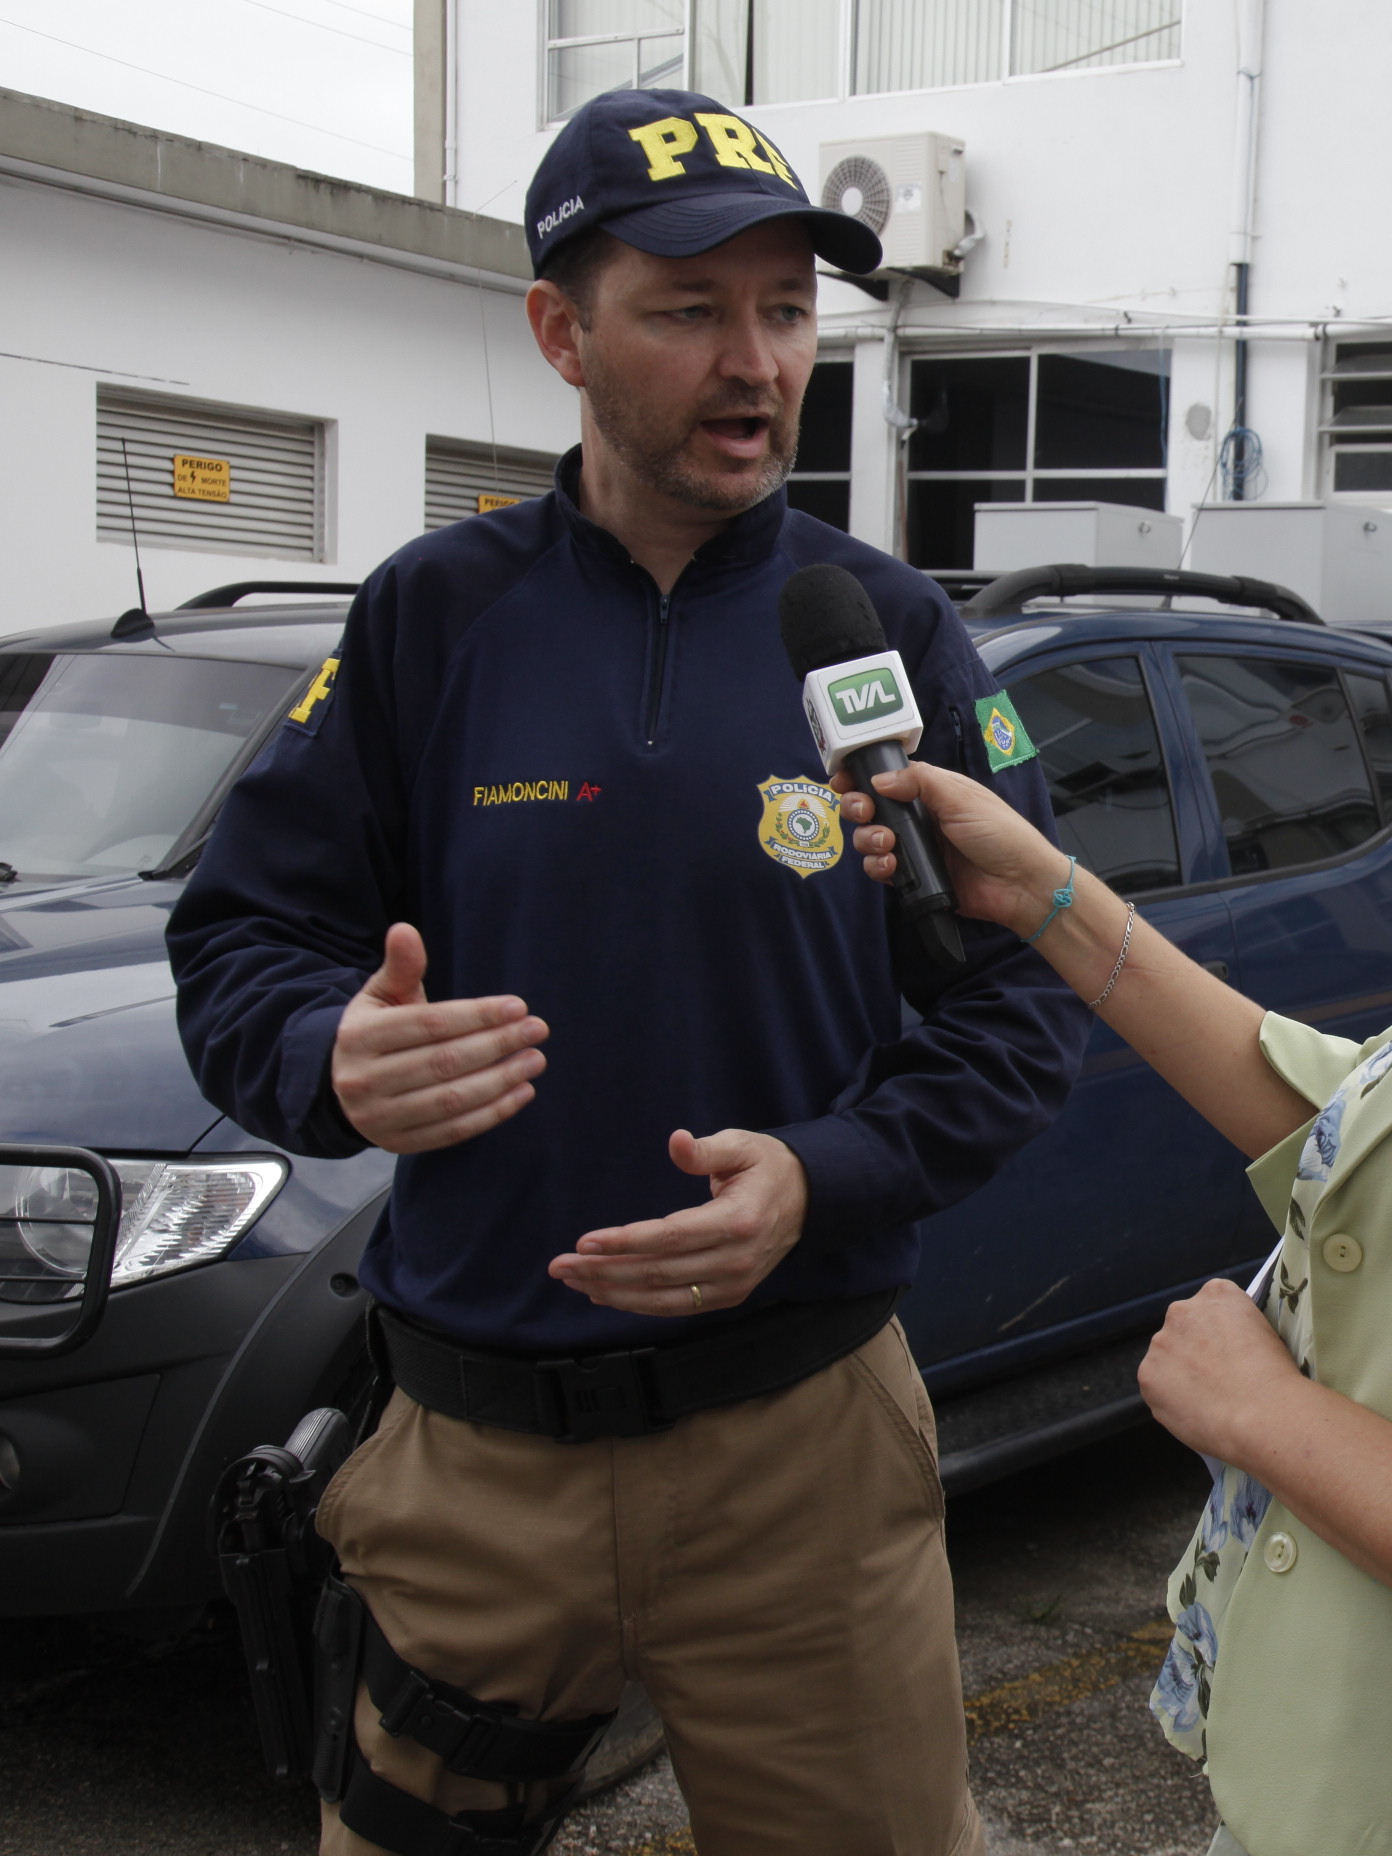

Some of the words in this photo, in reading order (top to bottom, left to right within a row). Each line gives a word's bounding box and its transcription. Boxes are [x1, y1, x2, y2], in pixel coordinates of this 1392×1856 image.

[181, 458, 223, 473] PERIGO
[177, 473, 188, 483] DE
[201, 477, 227, 487] MORTE
[177, 486, 196, 495] ALTA
[473, 780, 569, 807] FIAMONCINI
[576, 781, 602, 802] A+
[781, 855, 825, 869] FEDERAL
